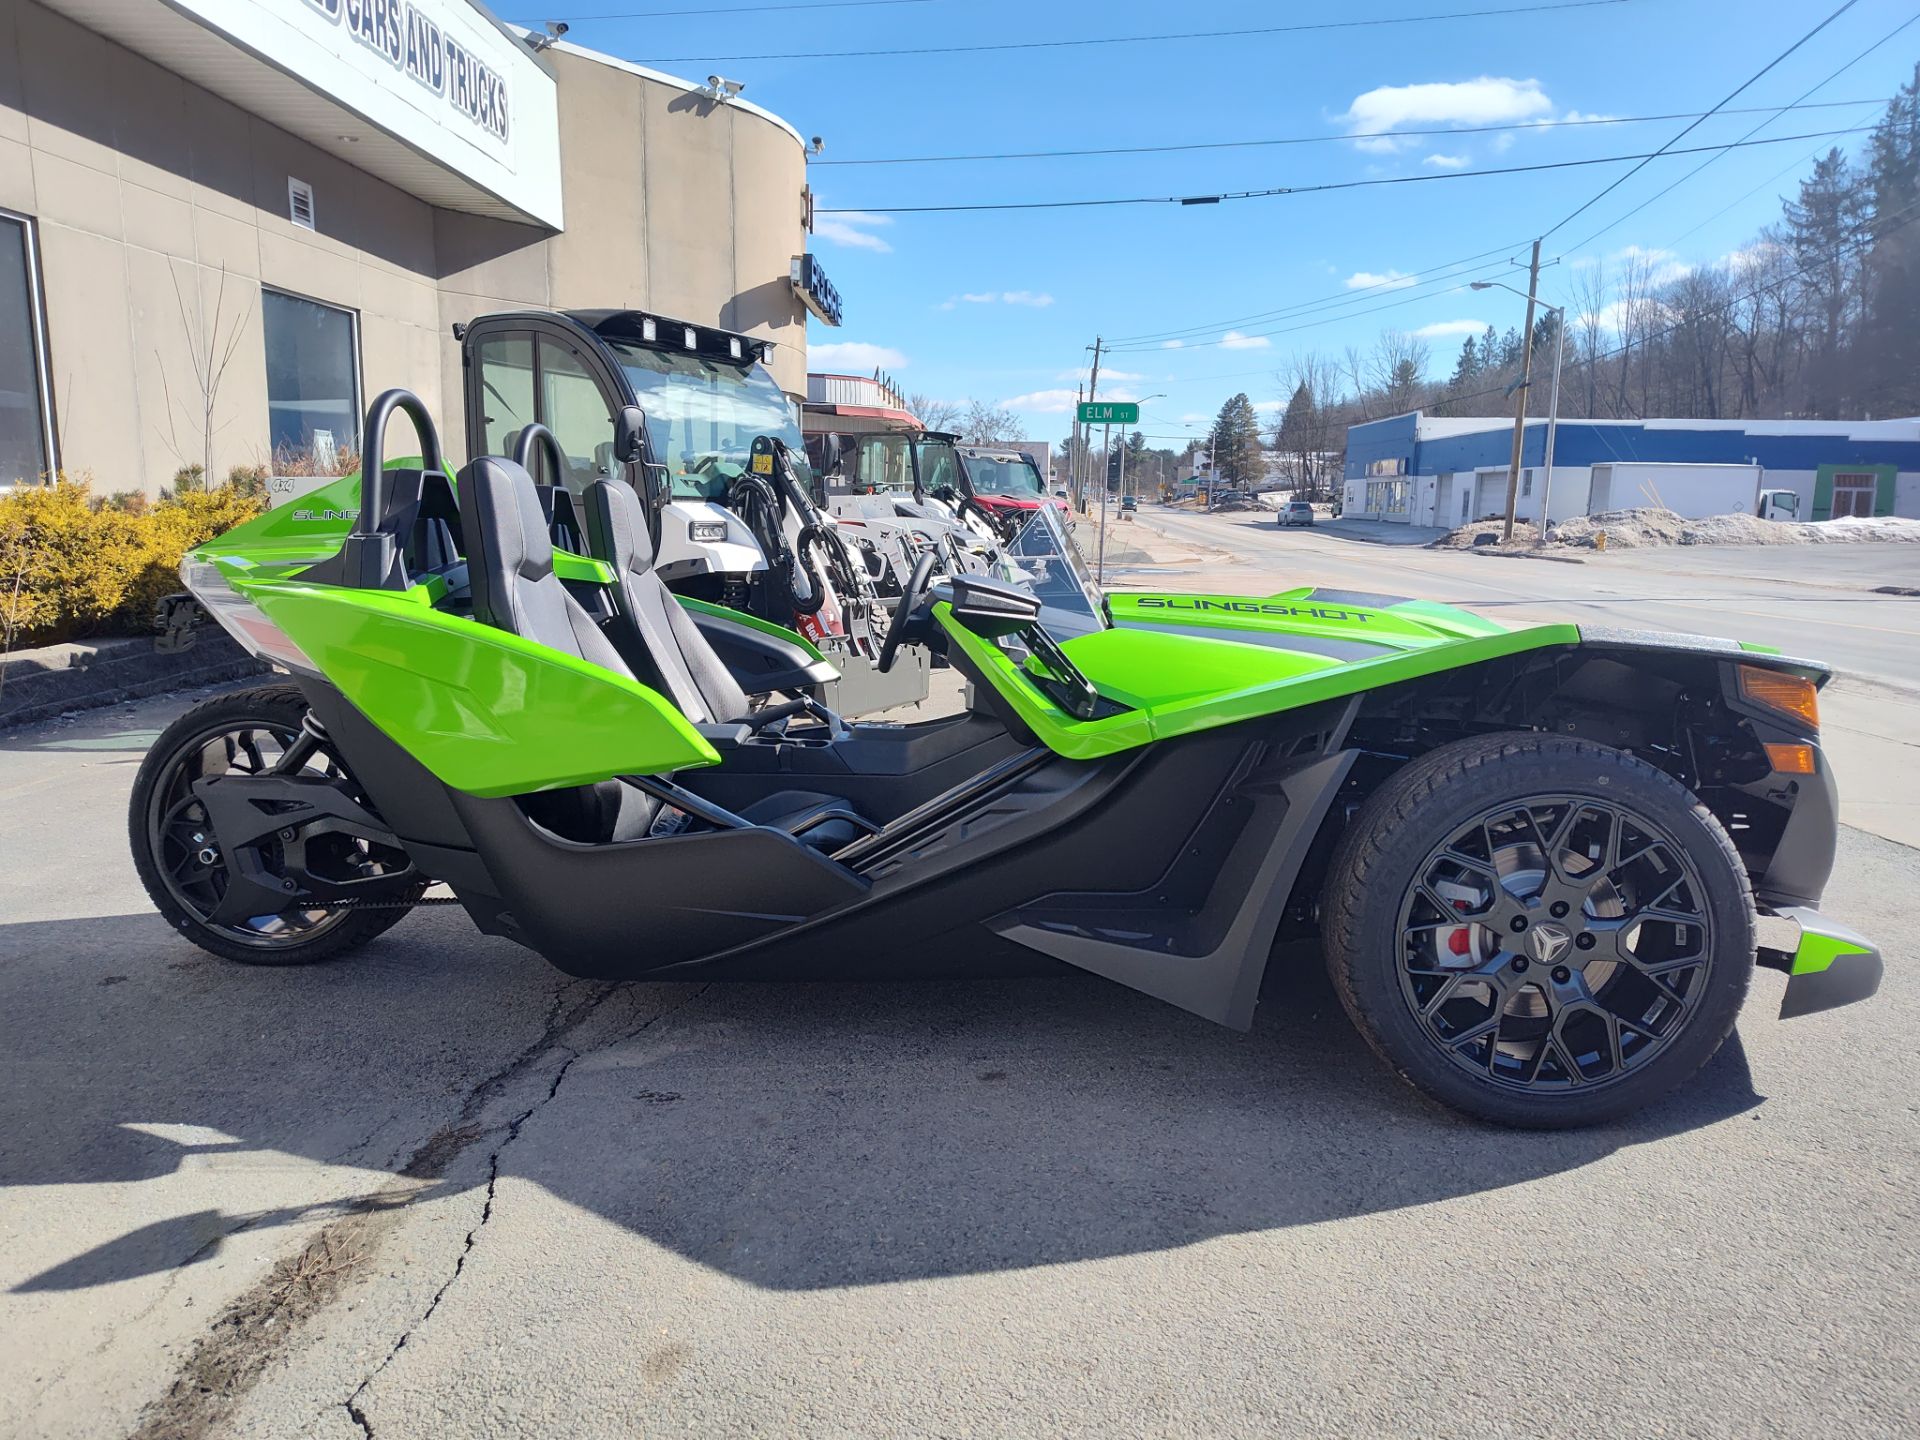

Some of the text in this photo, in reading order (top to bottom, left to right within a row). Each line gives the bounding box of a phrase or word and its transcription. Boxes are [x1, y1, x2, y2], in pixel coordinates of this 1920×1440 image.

[406, 7, 443, 91] AND
[446, 38, 507, 140] TRUCKS
[1086, 406, 1113, 419] ELM
[271, 479, 296, 493] 4x4
[1137, 597, 1376, 623] SLINGSHOT
